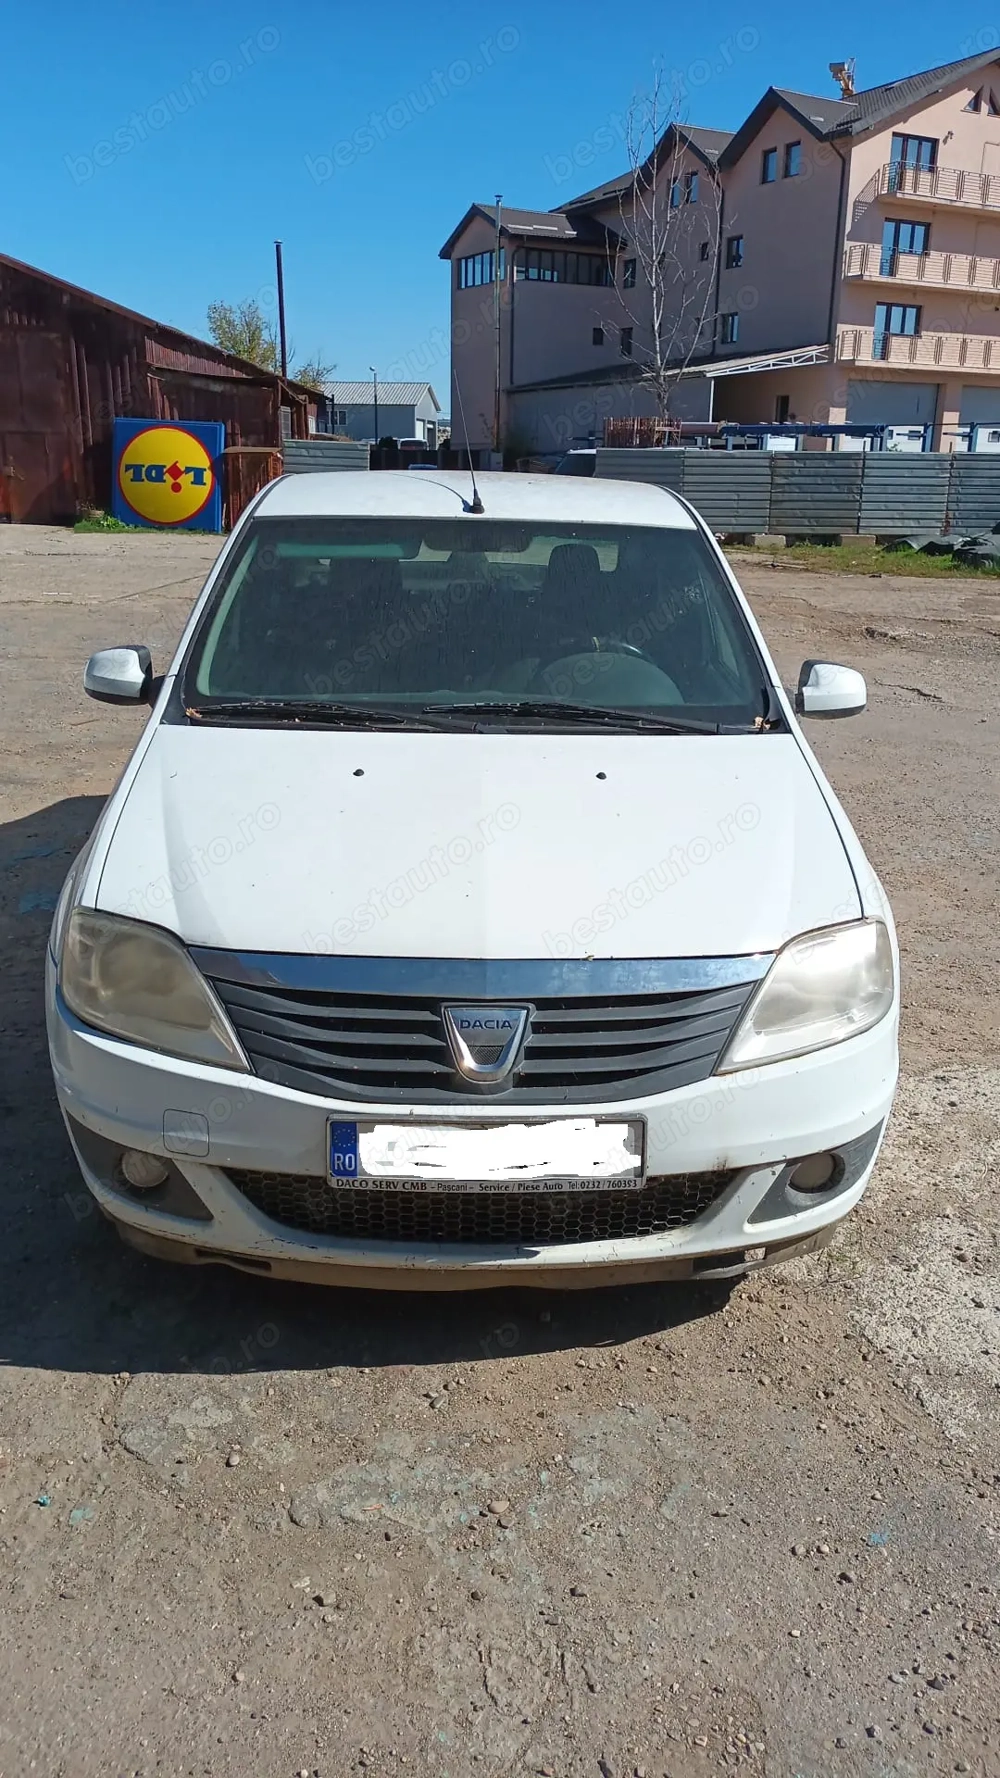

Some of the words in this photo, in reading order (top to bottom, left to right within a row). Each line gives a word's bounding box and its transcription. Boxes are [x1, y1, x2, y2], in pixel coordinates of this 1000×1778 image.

[460, 1019, 512, 1030] DACIA
[334, 1153, 356, 1171] RO
[336, 1179, 369, 1190] DACO
[372, 1180, 399, 1190] SERV
[402, 1181, 428, 1191] CMB
[478, 1182, 510, 1192] Service
[518, 1182, 542, 1192] Piese
[543, 1181, 564, 1191] Auto
